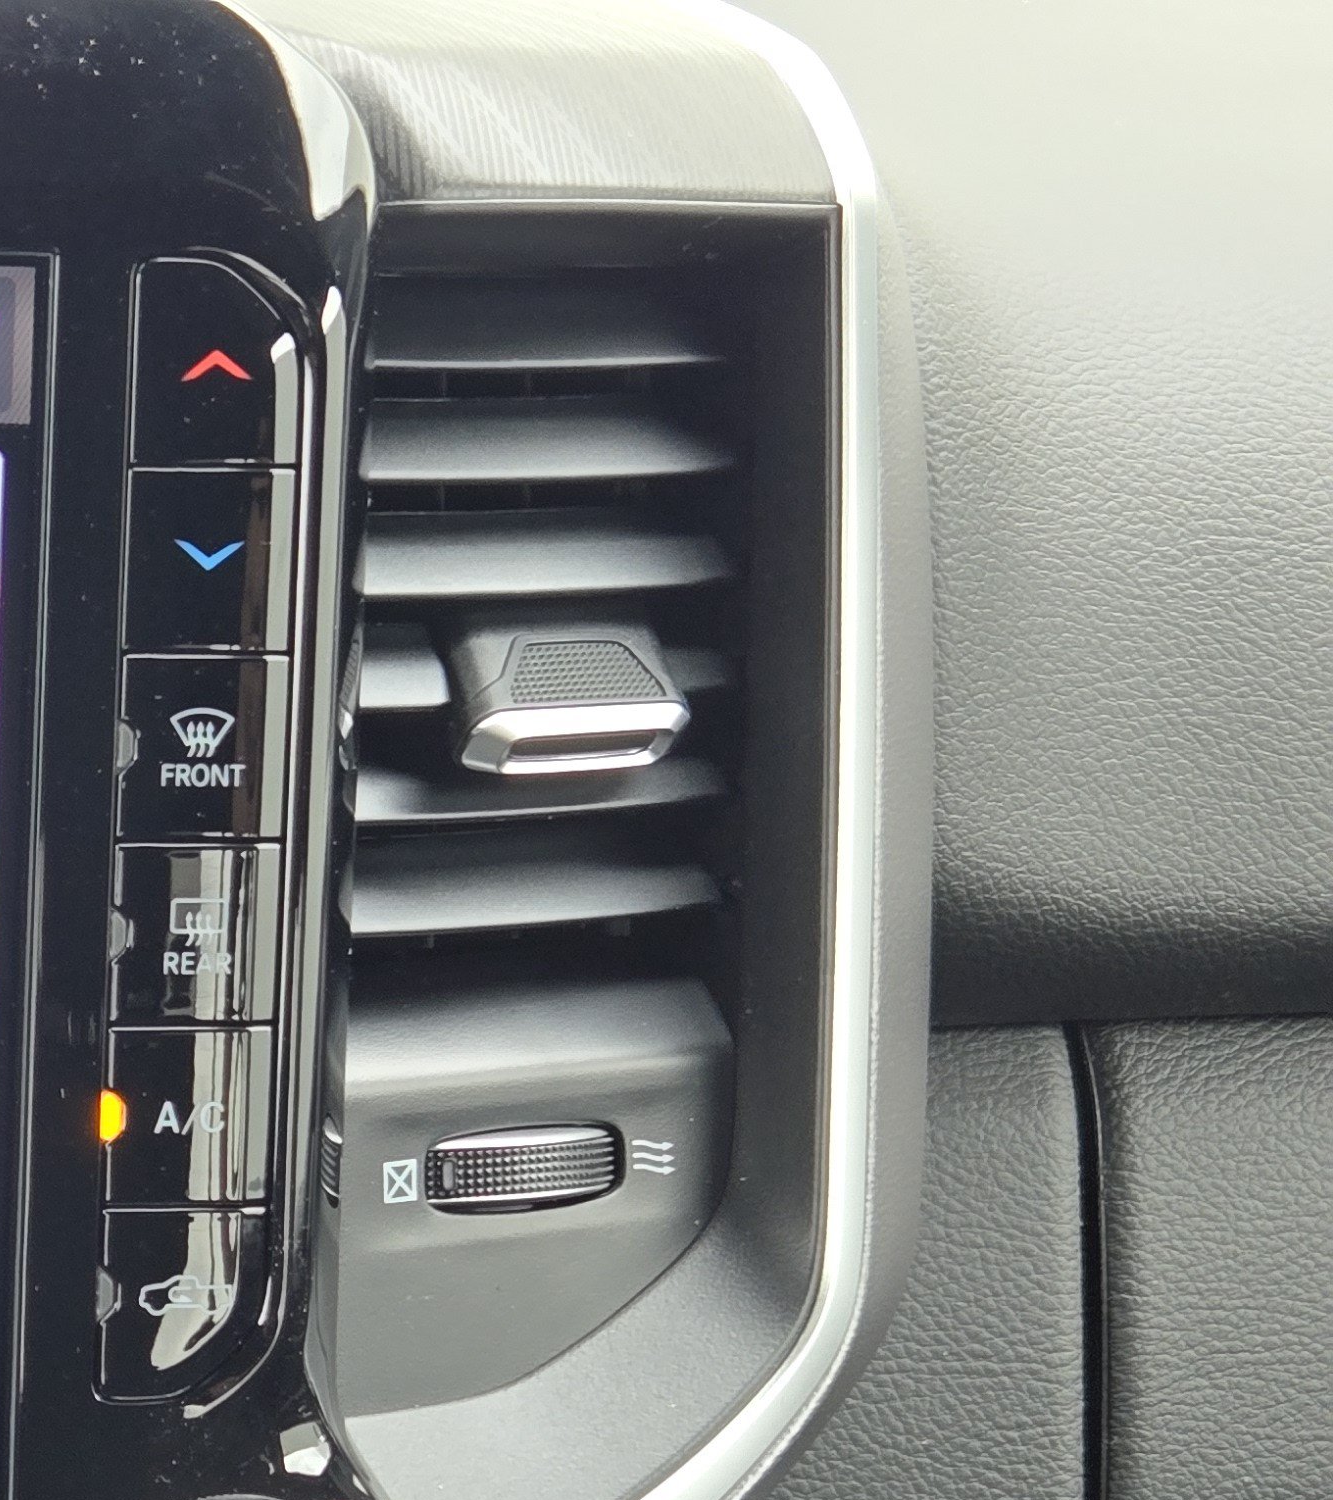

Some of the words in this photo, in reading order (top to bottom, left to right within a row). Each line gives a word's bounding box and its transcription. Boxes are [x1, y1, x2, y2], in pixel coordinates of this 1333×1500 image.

[160, 763, 245, 789] FRONT
[162, 951, 232, 976] REAR
[153, 1100, 226, 1136] A/C
